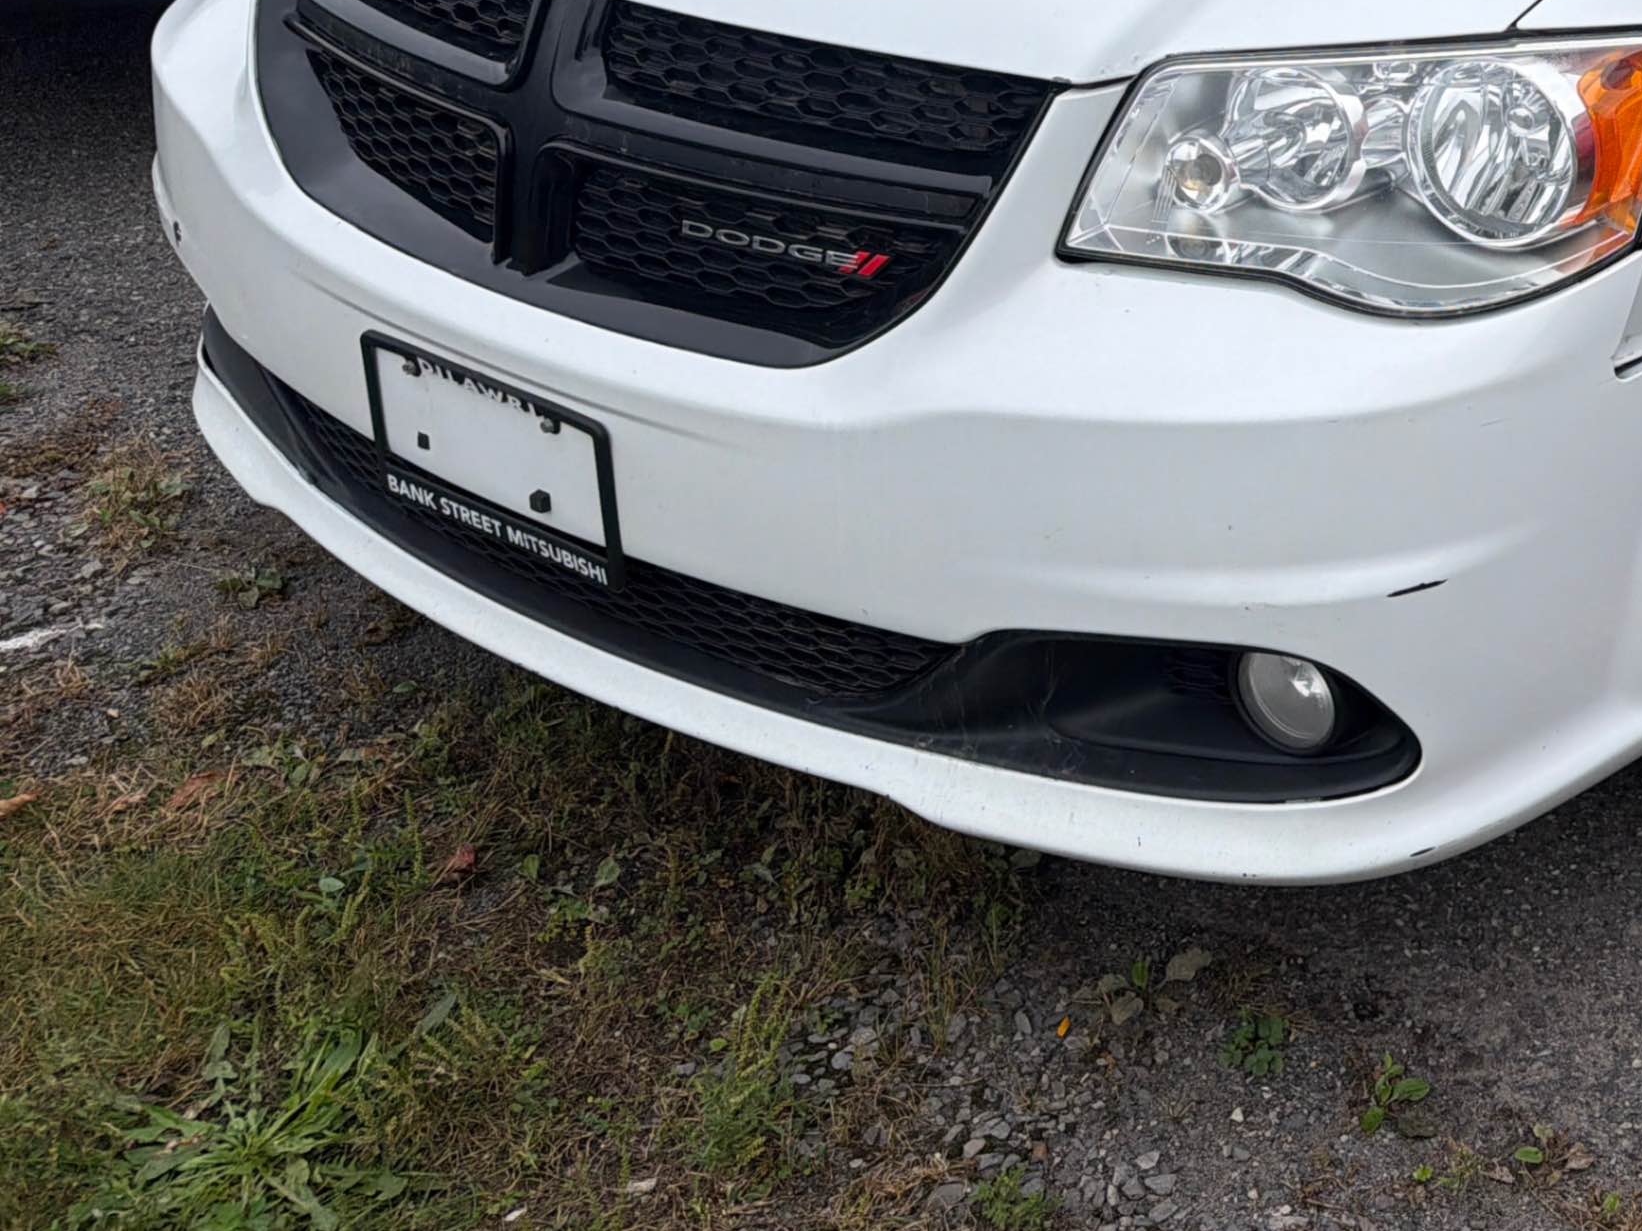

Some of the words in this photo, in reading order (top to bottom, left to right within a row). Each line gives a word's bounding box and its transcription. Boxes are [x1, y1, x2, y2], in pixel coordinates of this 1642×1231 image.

[681, 219, 860, 270] DODGE
[386, 473, 437, 510] BANK
[440, 497, 502, 536] STREET
[506, 525, 609, 586] MITSUBISHI
